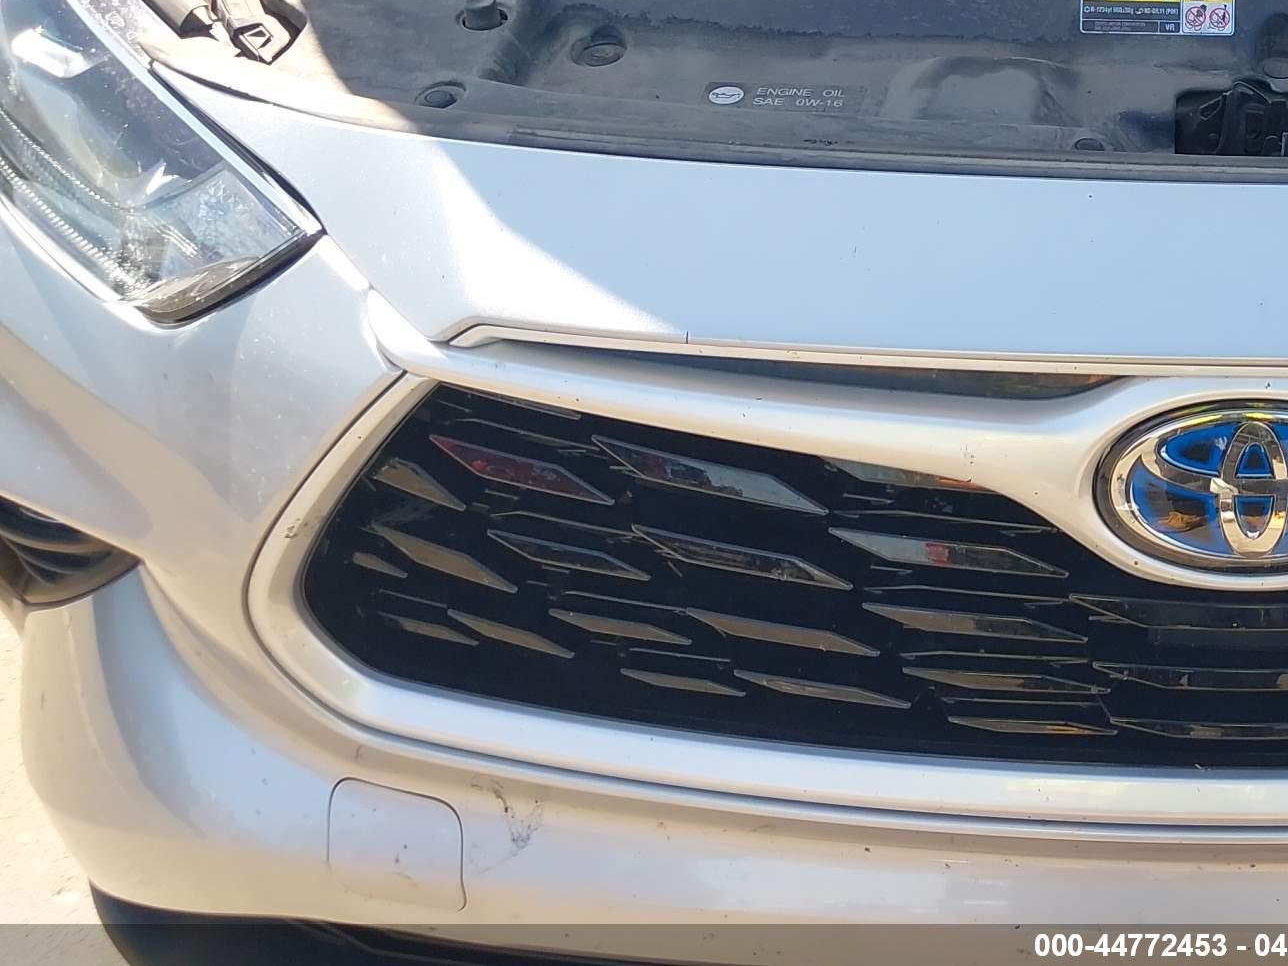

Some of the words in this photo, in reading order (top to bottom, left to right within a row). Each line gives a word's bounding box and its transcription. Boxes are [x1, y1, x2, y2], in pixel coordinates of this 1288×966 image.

[756, 87, 812, 97] ENGINE
[822, 89, 845, 98] OIL
[753, 97, 784, 106] SAE
[795, 98, 843, 107] 0W-16
